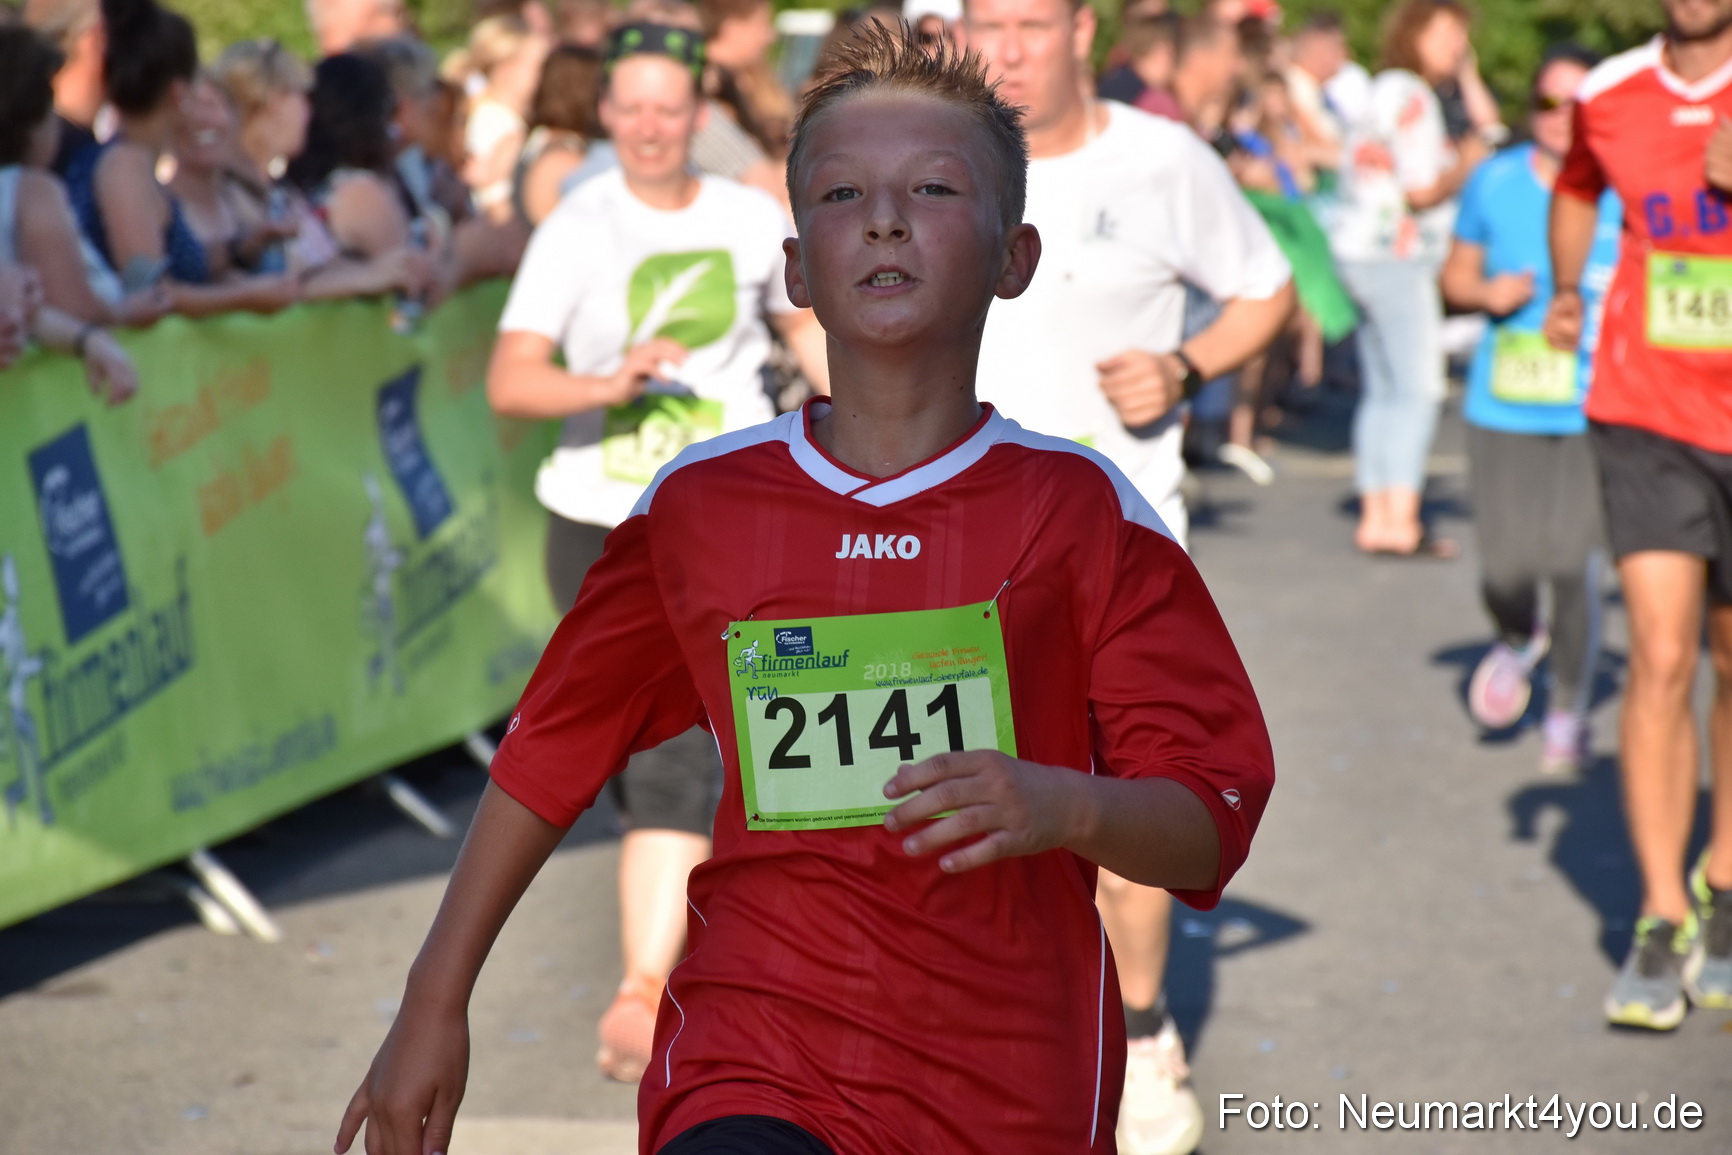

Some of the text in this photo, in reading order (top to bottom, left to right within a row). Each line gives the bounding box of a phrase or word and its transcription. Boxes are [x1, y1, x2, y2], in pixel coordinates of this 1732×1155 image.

[835, 534, 921, 560] JAKO
[781, 635, 807, 643] Fischer
[761, 649, 850, 671] firmenlauf
[864, 662, 912, 680] 2018
[876, 667, 988, 687] www.firmenlauf-oberpfalz.de
[764, 683, 965, 769] 2141
[812, 815, 833, 823] gedruckt
[844, 811, 877, 820] personalisiert
